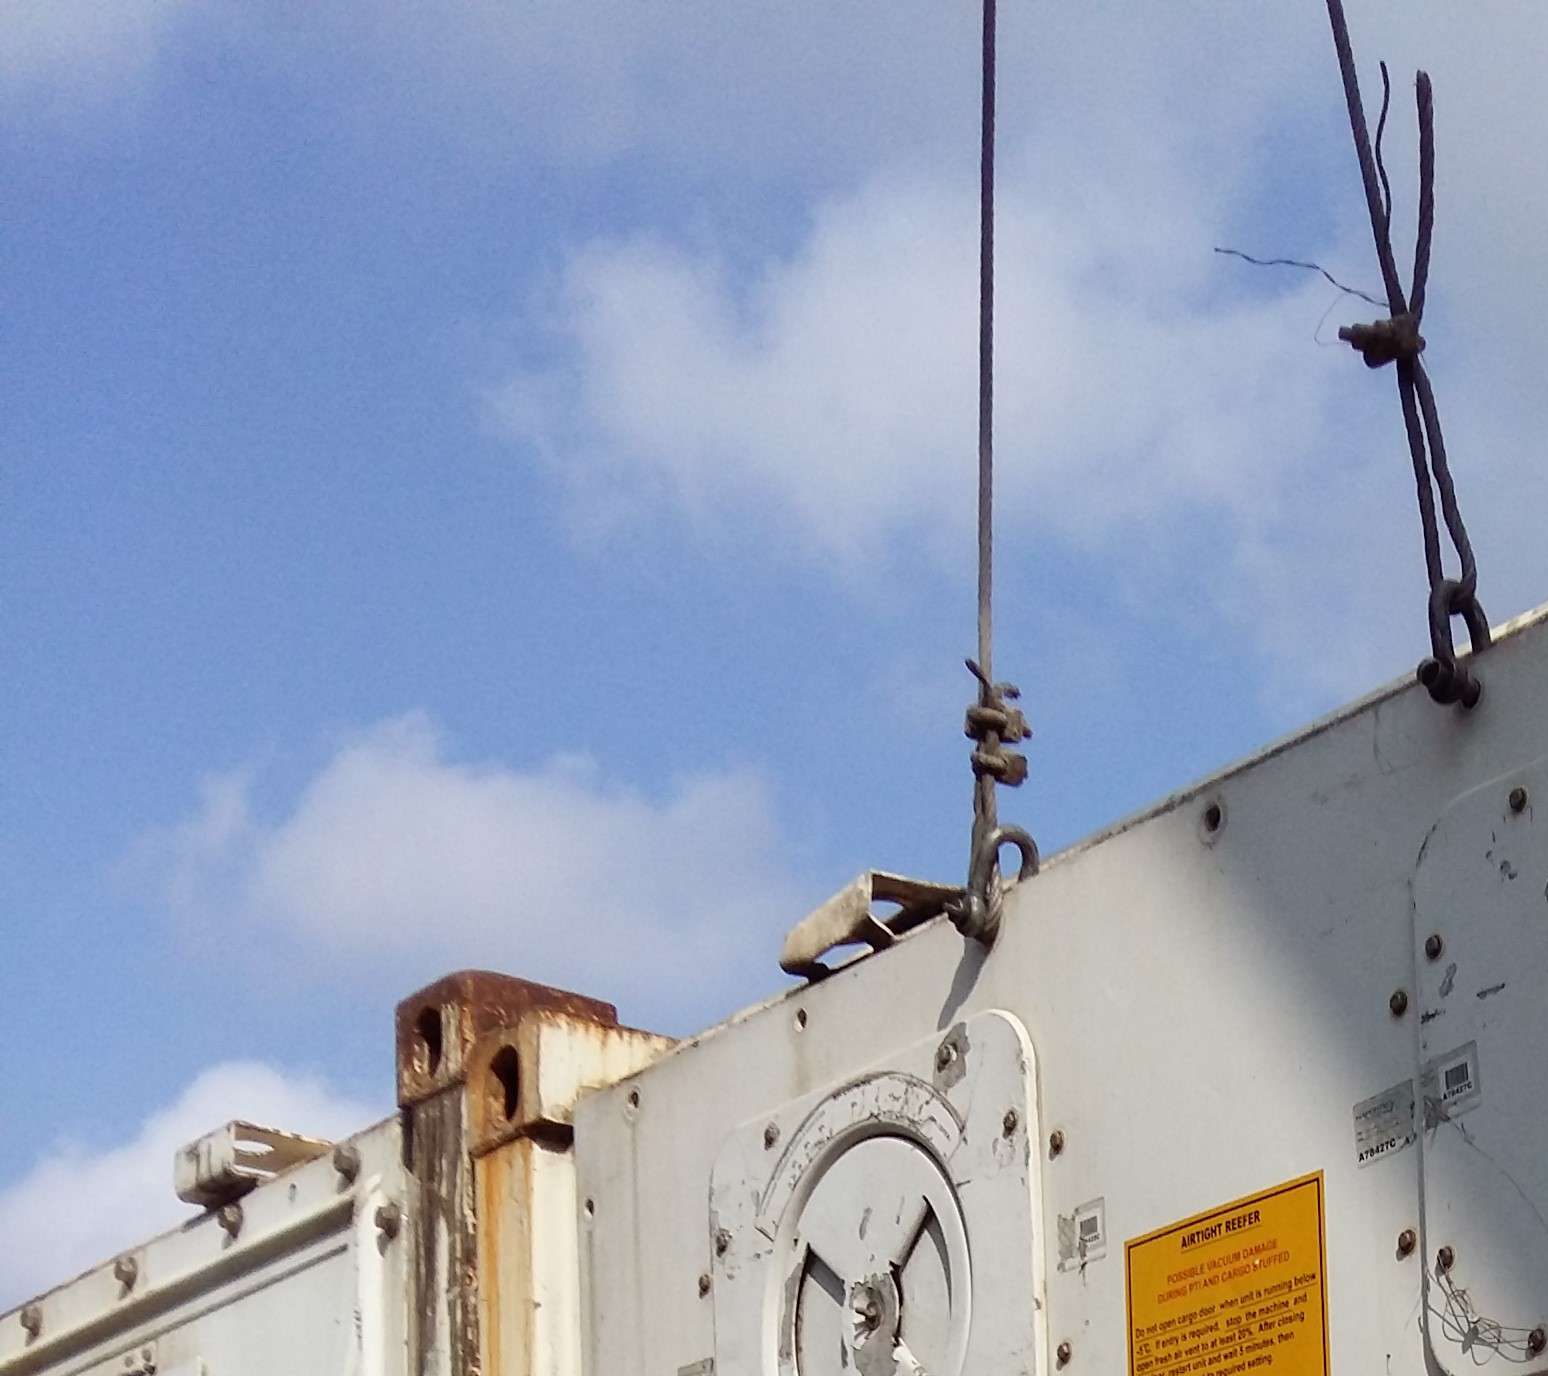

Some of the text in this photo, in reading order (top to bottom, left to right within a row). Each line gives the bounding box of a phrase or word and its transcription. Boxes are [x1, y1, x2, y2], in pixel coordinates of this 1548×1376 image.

[1358, 1137, 1397, 1162] A78427C
[1180, 1209, 1260, 1249] AIRTIGHT REEFER
[1167, 1238, 1276, 1285] POSSIBLE VACUUM DAMAGE
[1221, 1264, 1250, 1282] CARGO
[1293, 1270, 1315, 1286] below
